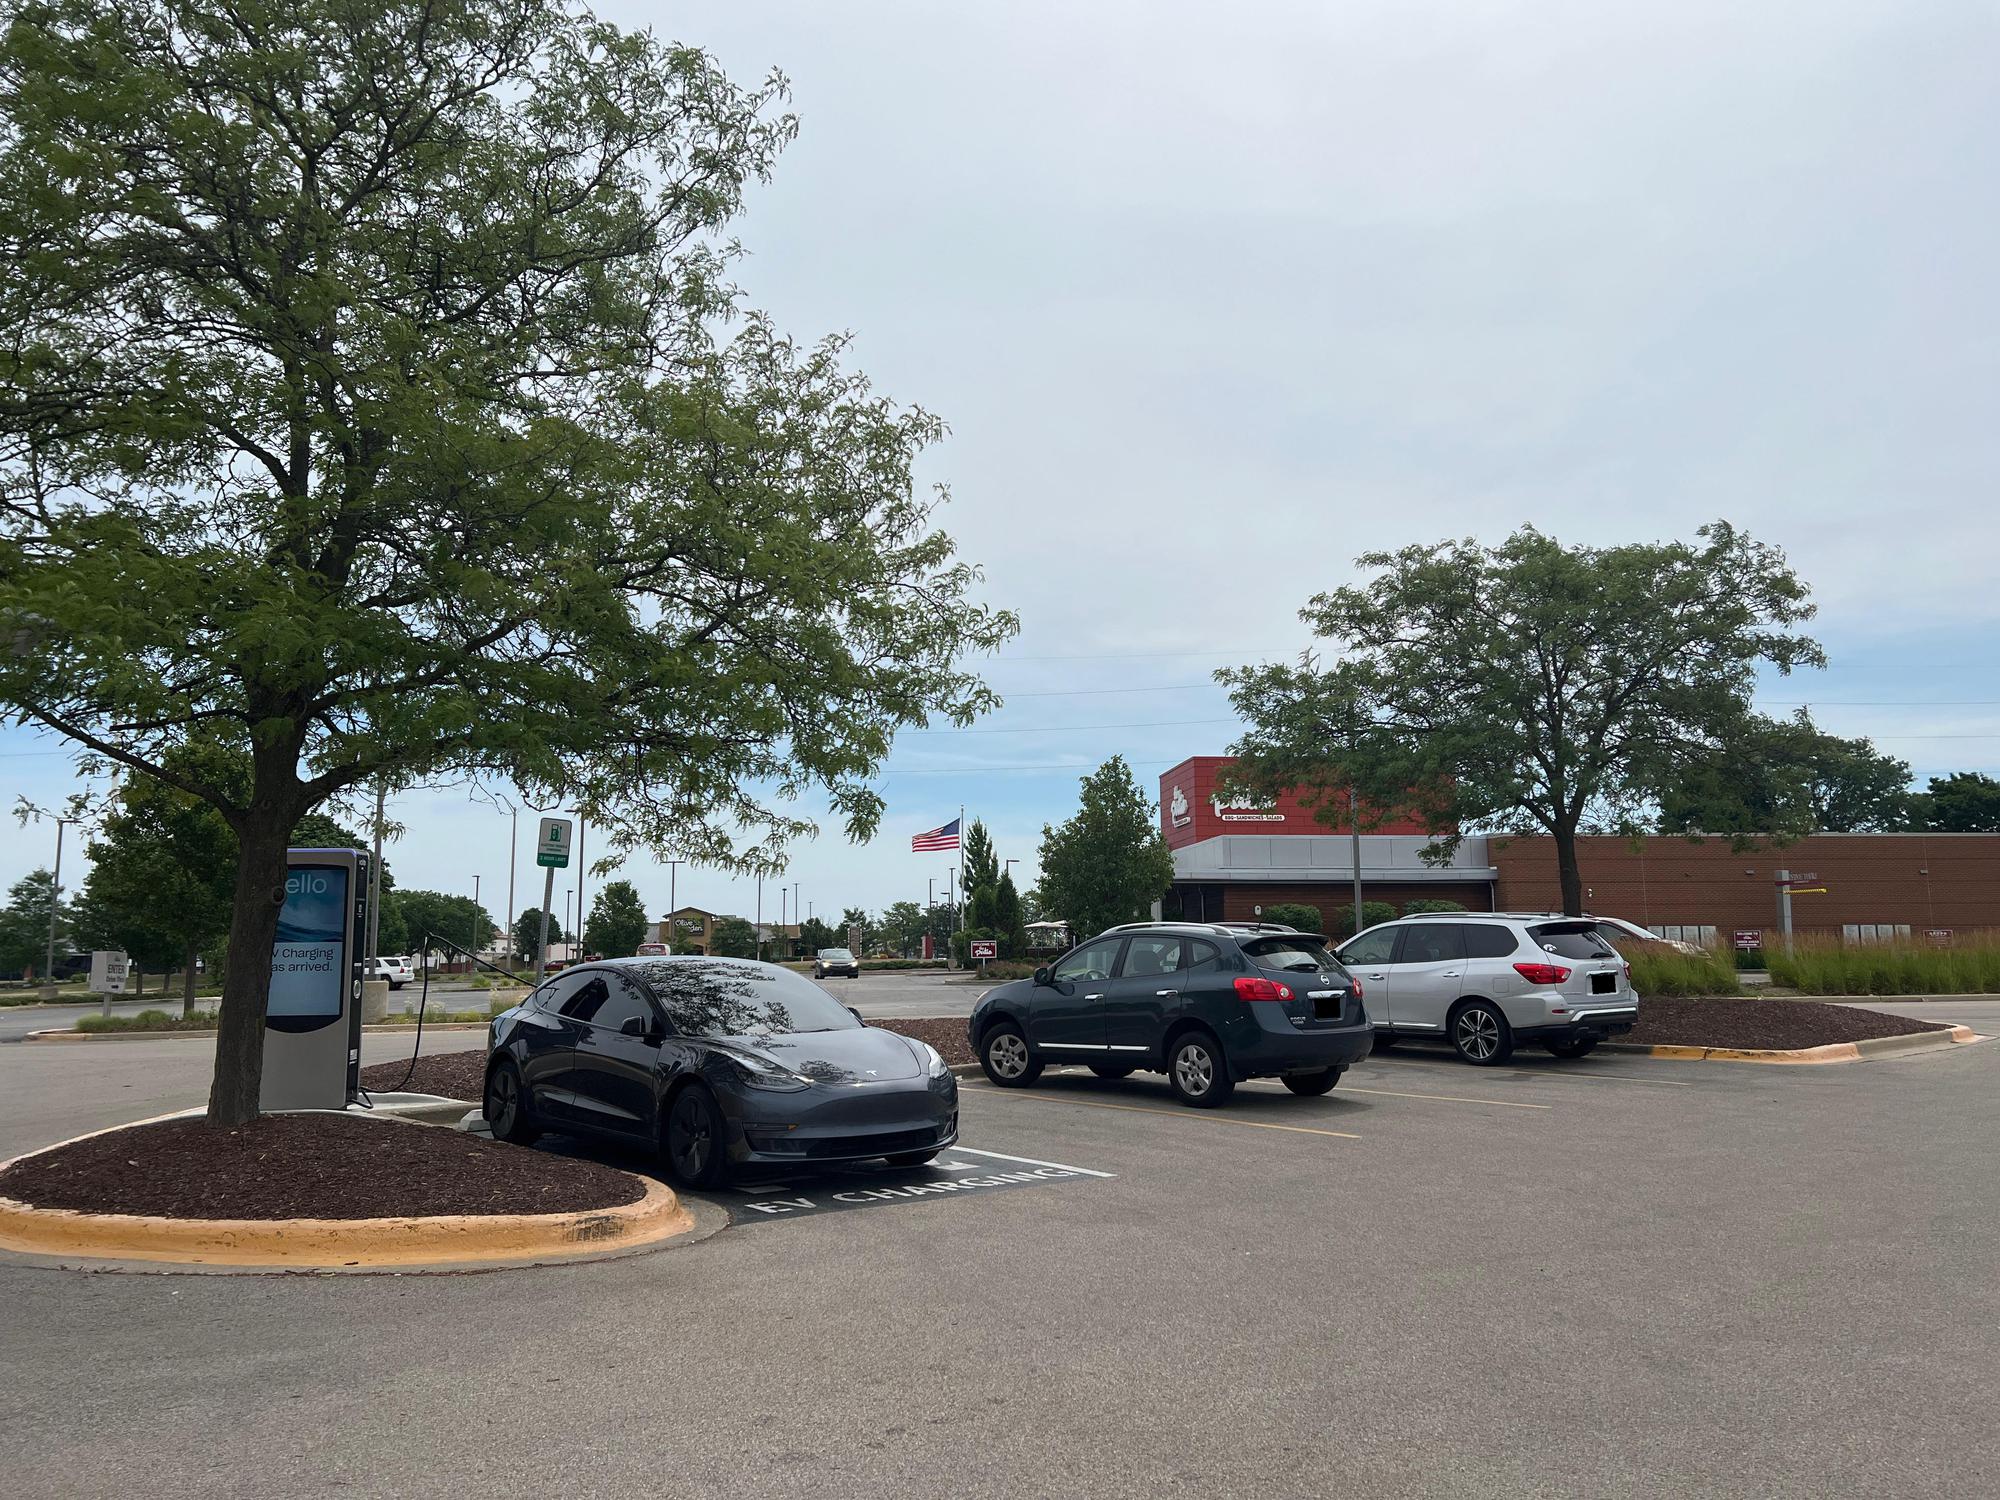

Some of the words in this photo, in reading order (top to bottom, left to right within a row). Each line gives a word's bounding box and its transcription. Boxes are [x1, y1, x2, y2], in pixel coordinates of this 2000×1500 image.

[285, 874, 327, 893] ello
[272, 949, 279, 957] V
[282, 949, 334, 961] Charging
[108, 964, 125, 974] ENTER
[271, 963, 285, 971] as
[288, 962, 333, 972] arrived.
[745, 1197, 817, 1214] EV
[832, 1168, 1079, 1203] CHARGING
